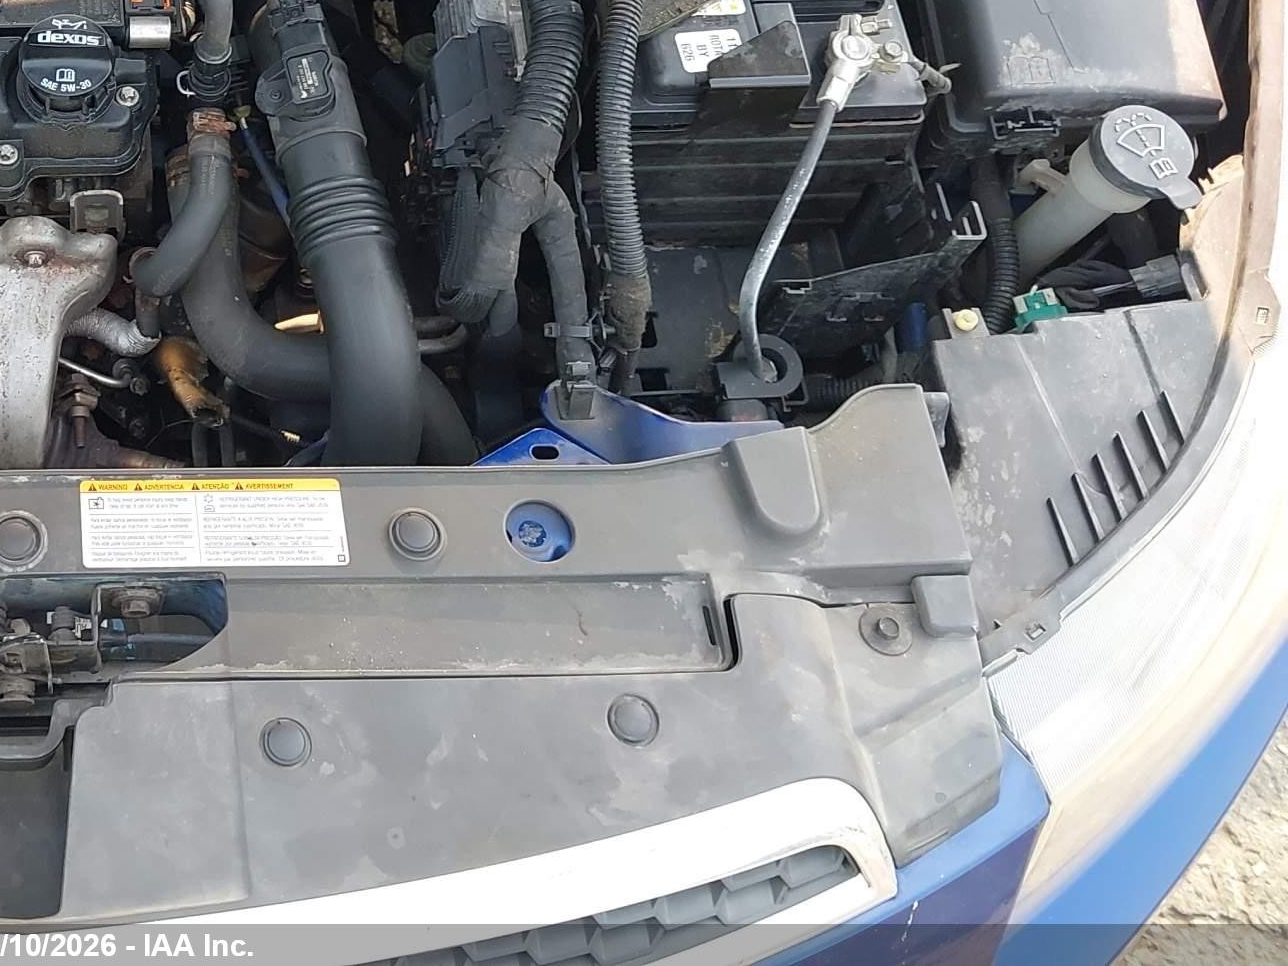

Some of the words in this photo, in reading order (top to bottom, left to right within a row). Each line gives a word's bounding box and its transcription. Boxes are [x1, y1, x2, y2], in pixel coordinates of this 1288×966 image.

[37, 30, 102, 46] dexos
[40, 77, 59, 91] SAE
[60, 79, 92, 92] 5W-30
[201, 482, 230, 490] ATENÇÃO
